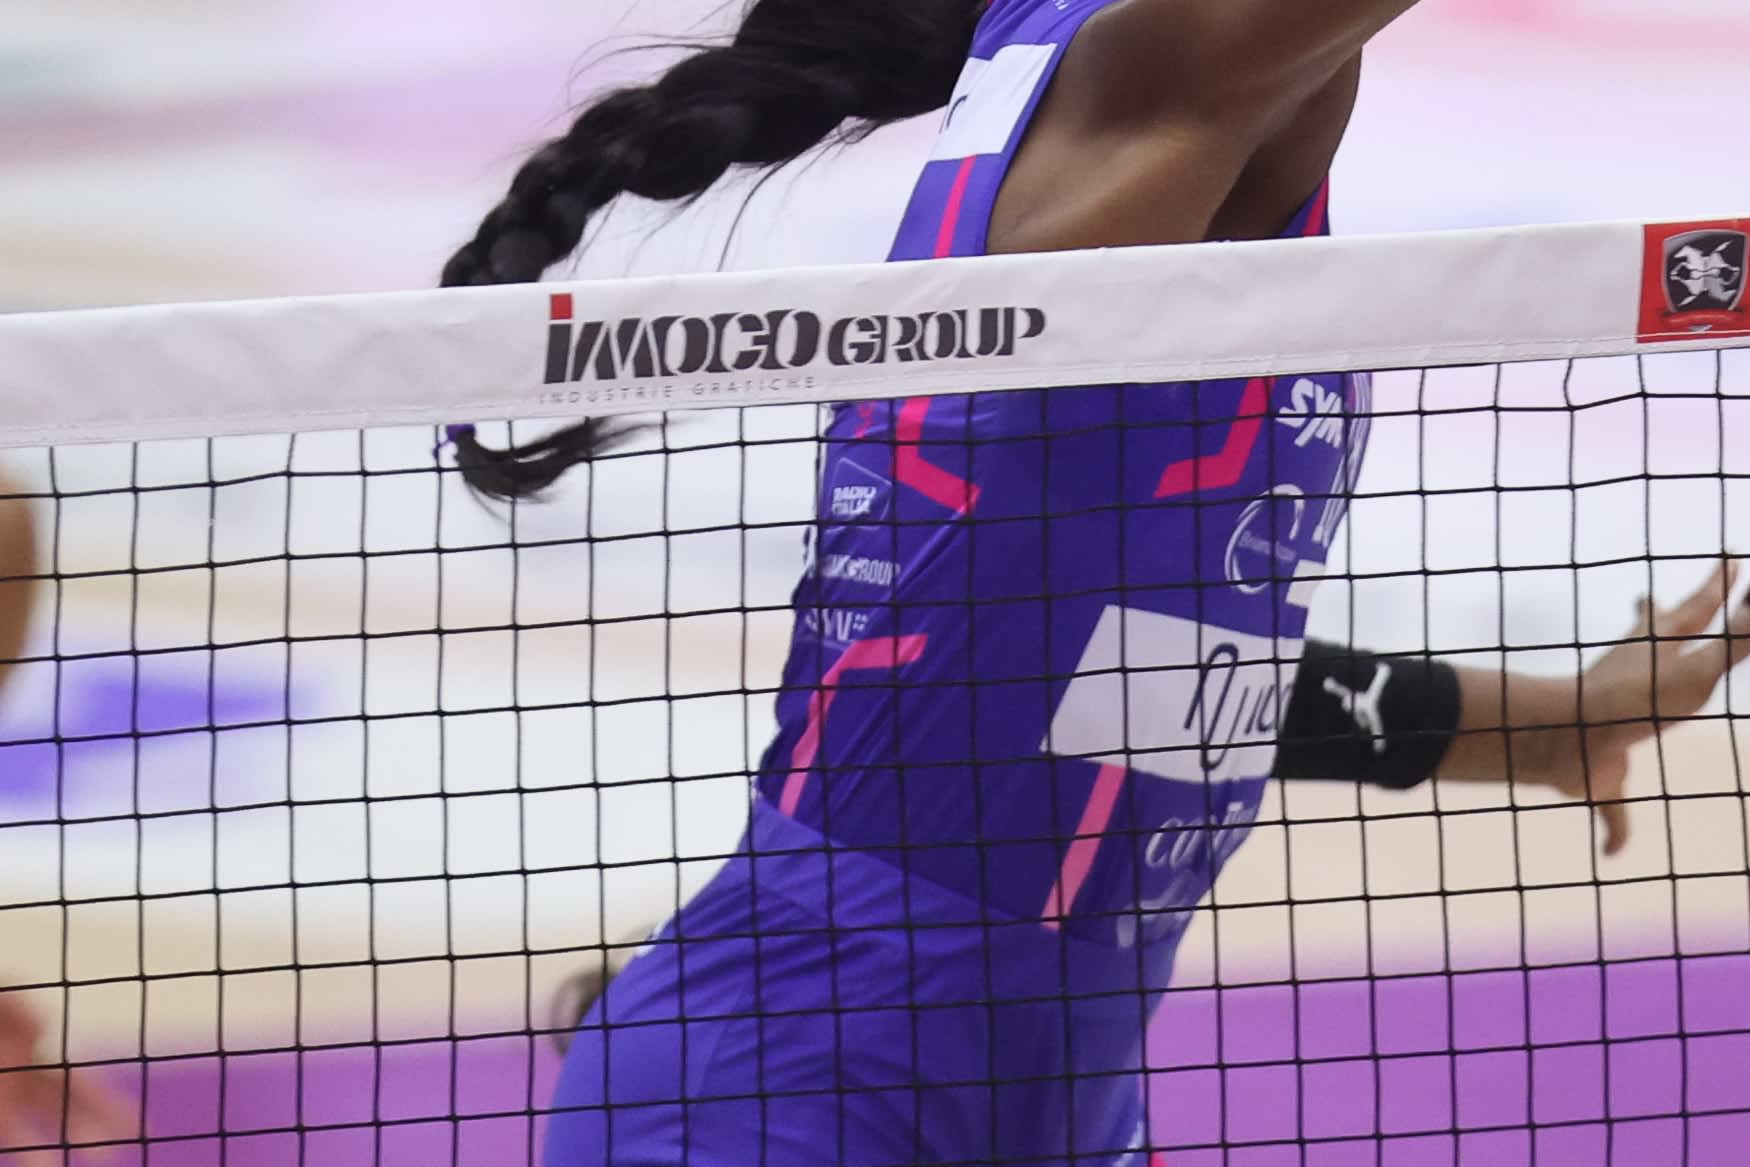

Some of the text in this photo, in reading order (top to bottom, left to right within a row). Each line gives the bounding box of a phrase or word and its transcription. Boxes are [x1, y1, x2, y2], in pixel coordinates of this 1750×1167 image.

[826, 307, 1046, 367] GROUP
[538, 375, 816, 405] INDUSTRIE GRAFICHE
